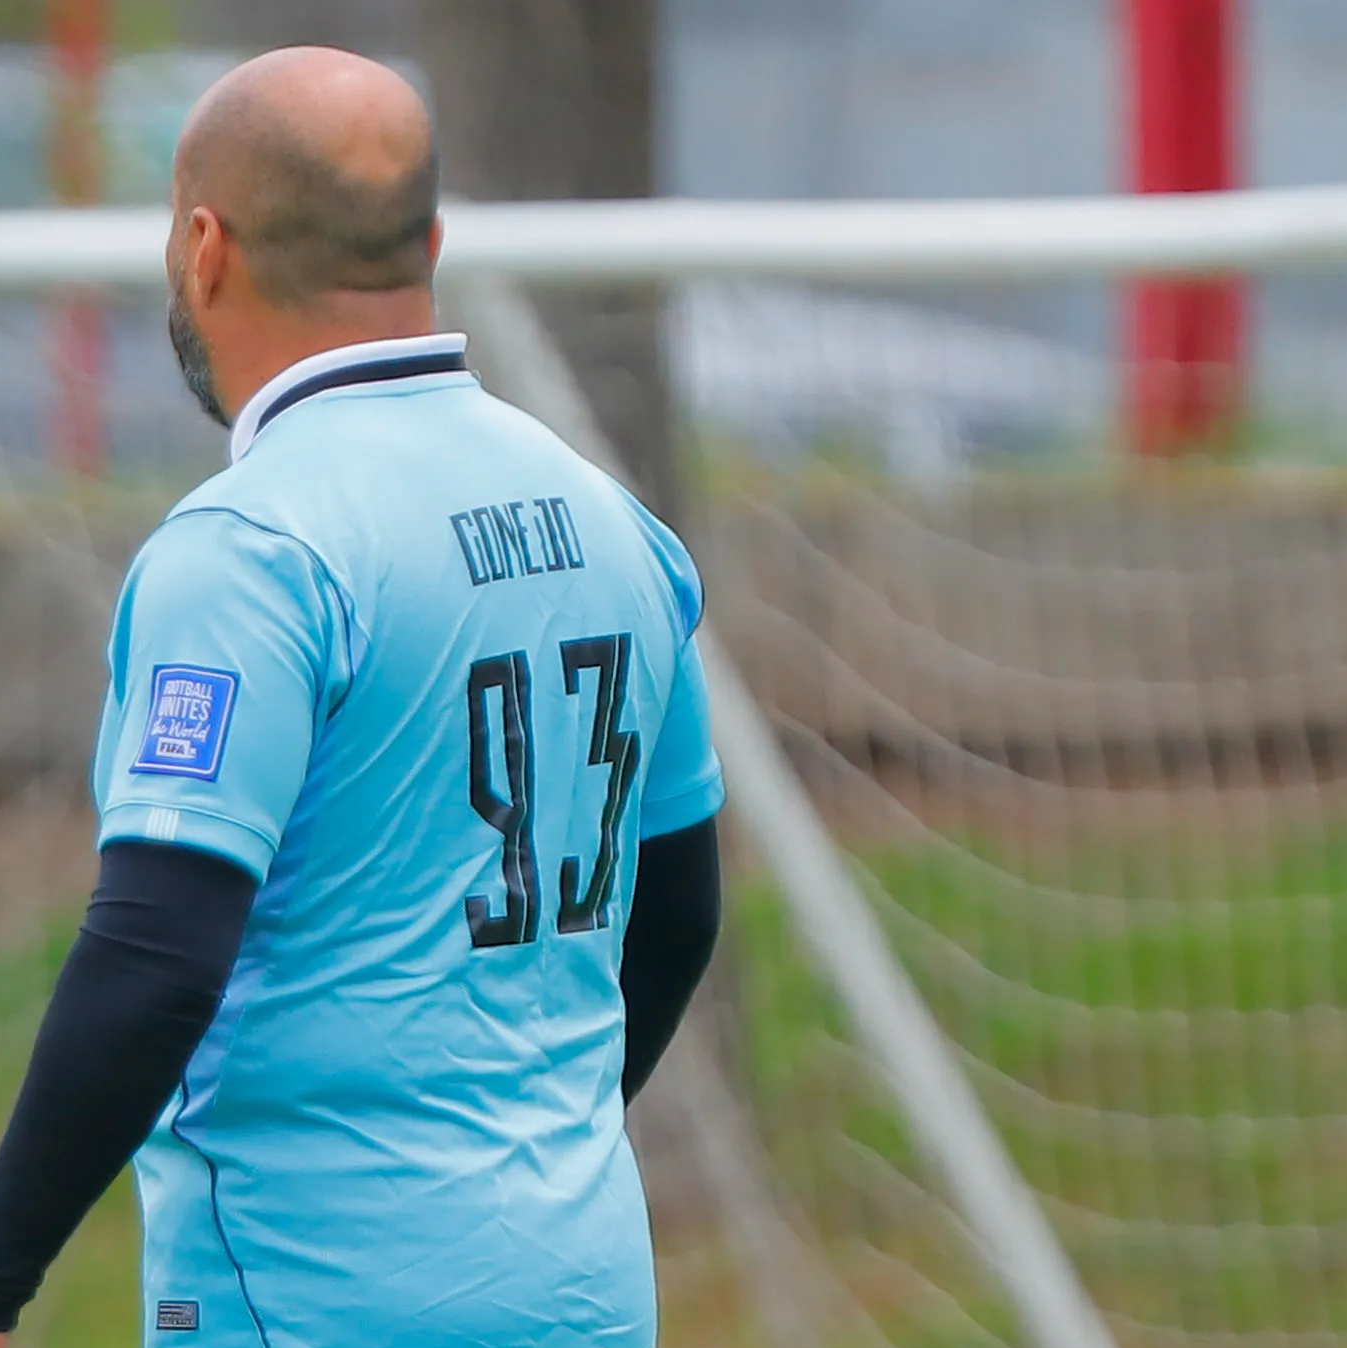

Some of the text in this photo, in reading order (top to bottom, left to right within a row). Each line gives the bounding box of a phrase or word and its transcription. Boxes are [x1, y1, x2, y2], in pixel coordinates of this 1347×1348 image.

[449, 497, 585, 587] CONEJO
[159, 741, 185, 755] FIFA
[465, 632, 640, 949] 93
